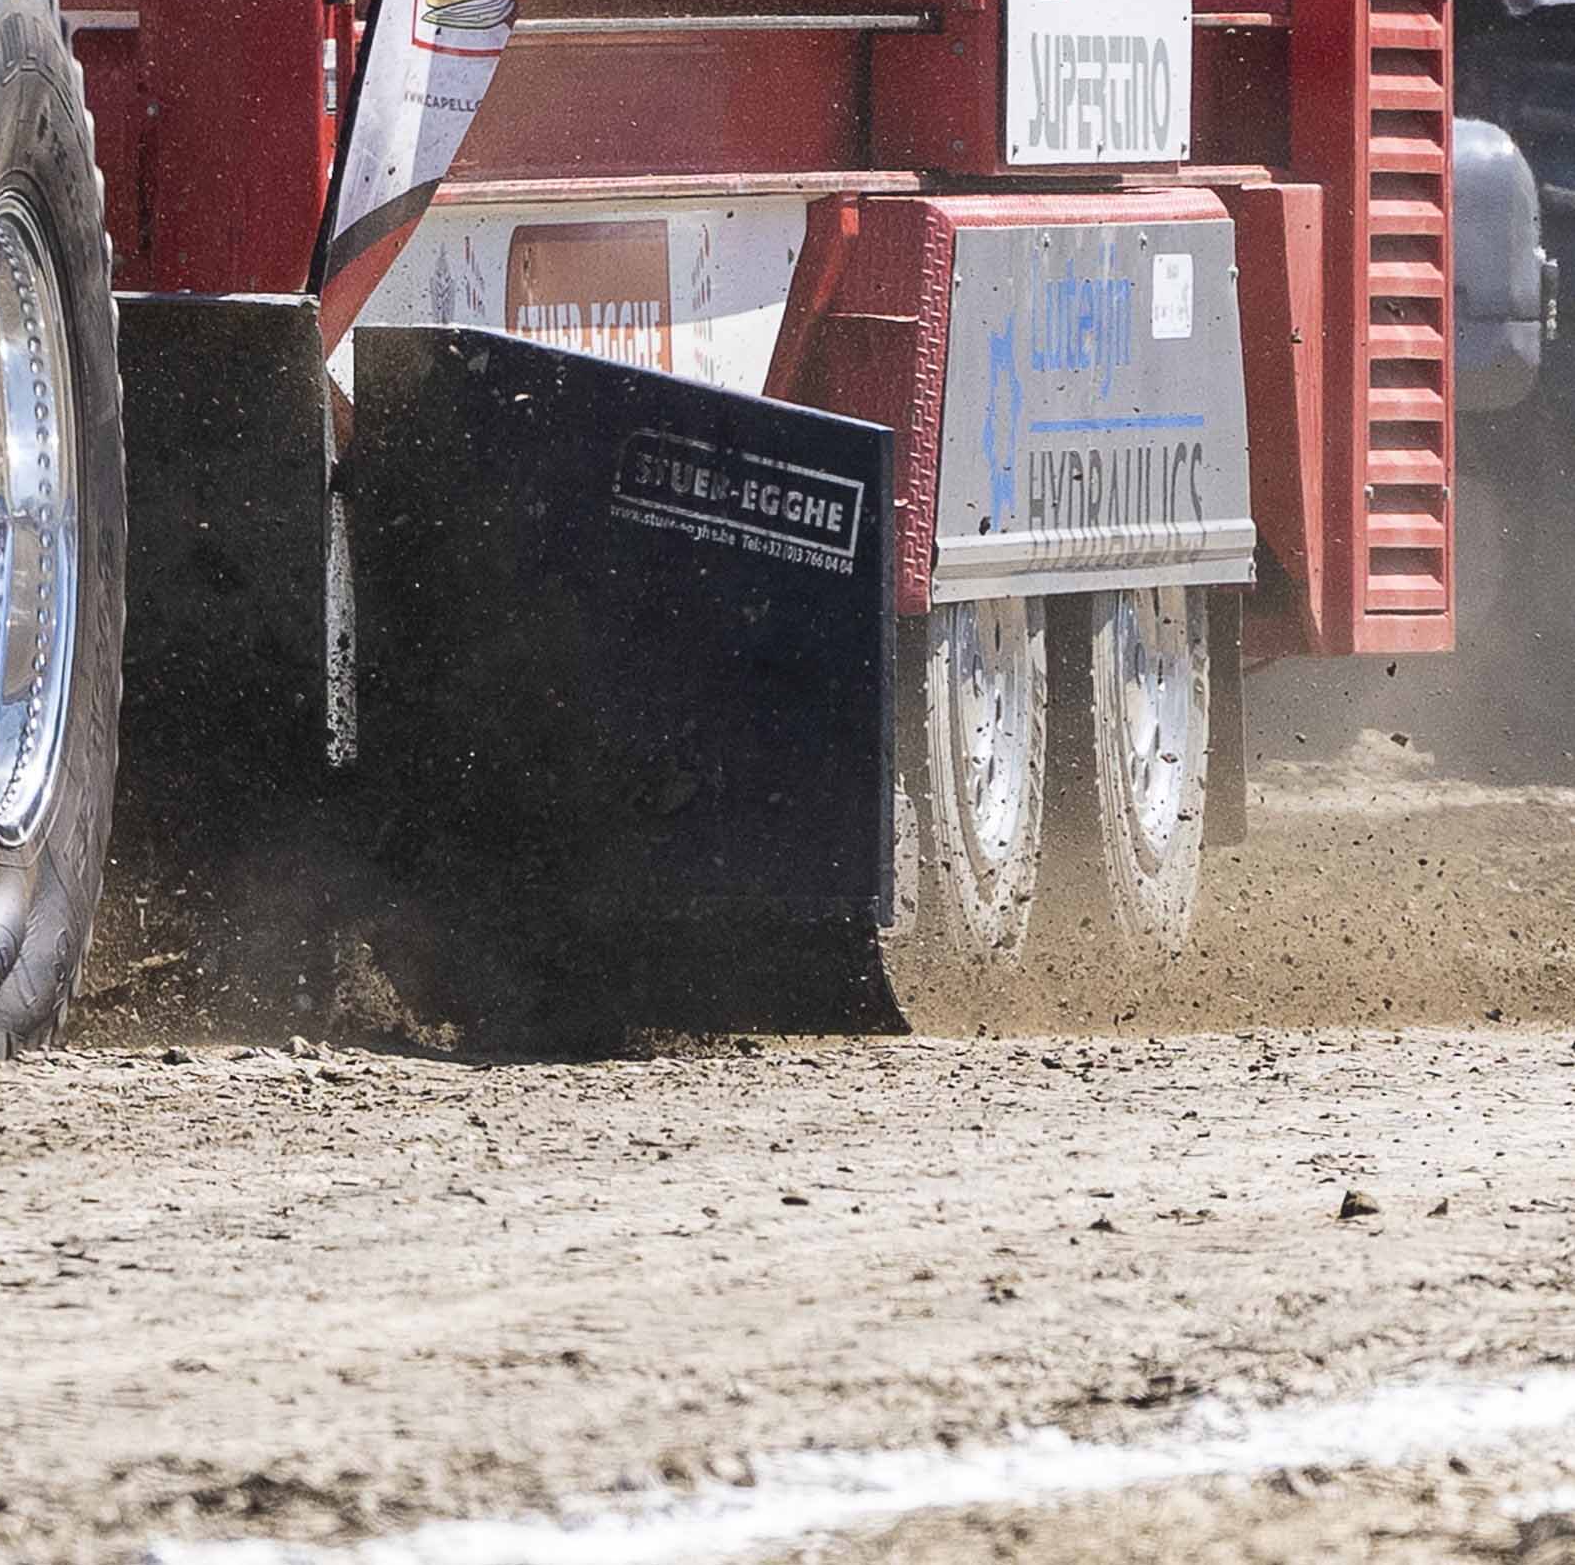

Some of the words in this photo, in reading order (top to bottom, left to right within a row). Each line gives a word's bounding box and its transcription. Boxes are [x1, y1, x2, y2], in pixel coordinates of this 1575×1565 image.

[1028, 32, 1171, 152] SUPERTINO
[634, 452, 844, 533] STUER-EGGHE
[1028, 442, 1206, 571] HYDRAULICS
